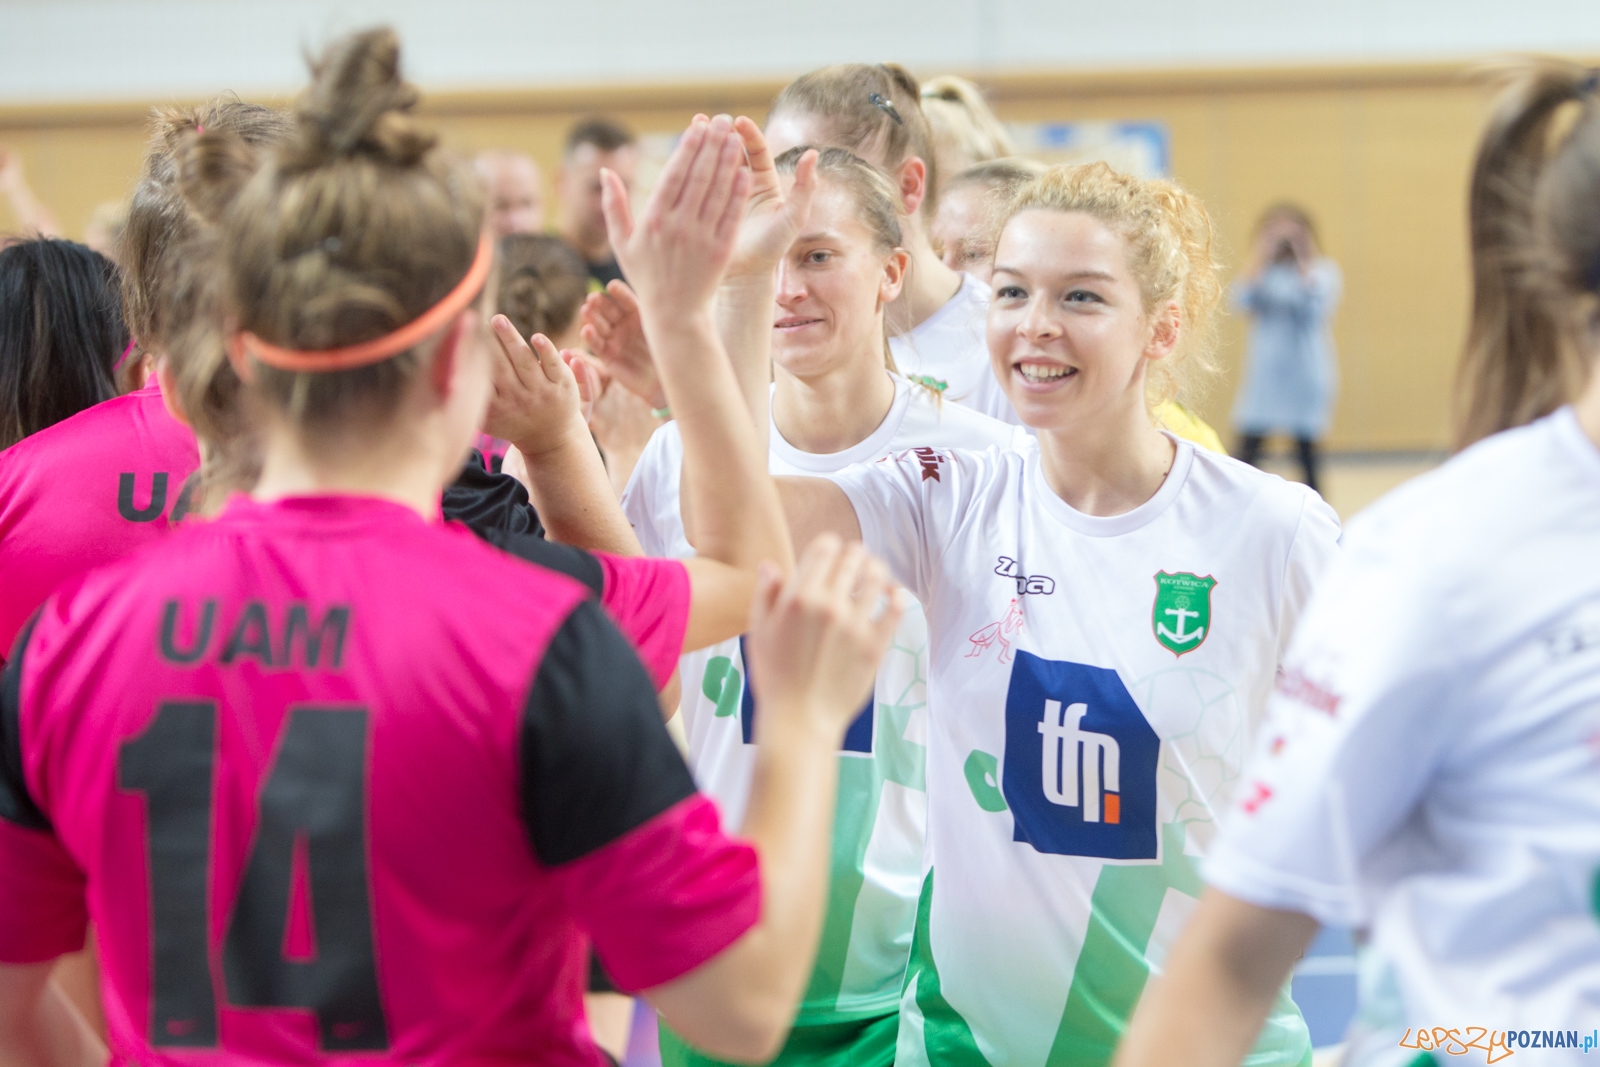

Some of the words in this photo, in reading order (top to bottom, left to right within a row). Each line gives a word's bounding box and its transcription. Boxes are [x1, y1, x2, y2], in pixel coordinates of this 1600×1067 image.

[1160, 577, 1209, 589] KOTWICA
[159, 600, 351, 669] UAM
[118, 702, 391, 1052] 14
